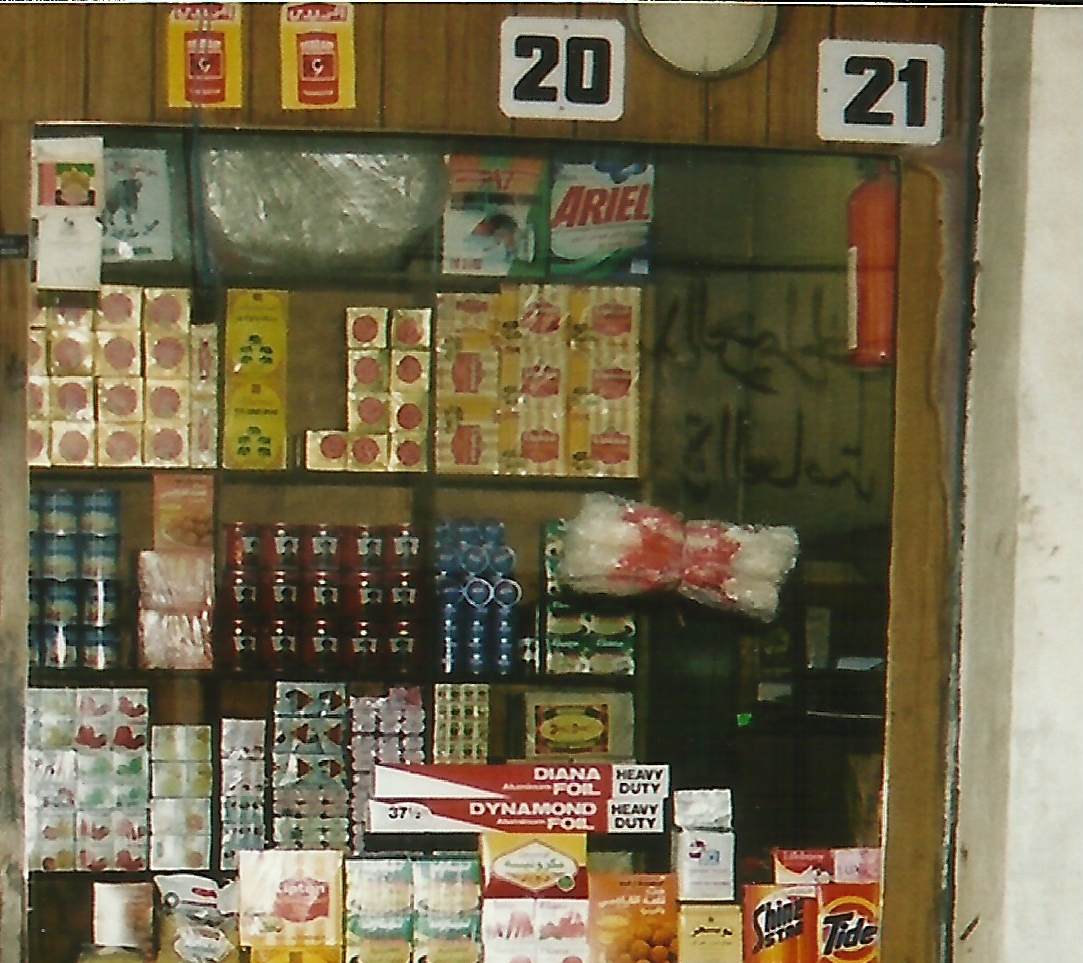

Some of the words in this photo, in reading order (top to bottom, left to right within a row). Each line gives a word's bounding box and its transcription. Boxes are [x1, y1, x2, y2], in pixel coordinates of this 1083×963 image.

[514, 35, 611, 104] 20
[843, 56, 928, 127] 21
[552, 183, 652, 229] ARIEL
[533, 767, 601, 781] DIANA
[617, 768, 663, 781] HEAVY
[552, 782, 601, 796] FOIL
[619, 782, 660, 795] DUTY
[469, 801, 597, 815] DYNAMOND
[611, 803, 658, 816] HEAVY
[546, 817, 595, 831] FOIL
[614, 816, 656, 829] DUTY
[821, 911, 878, 956] Tide
